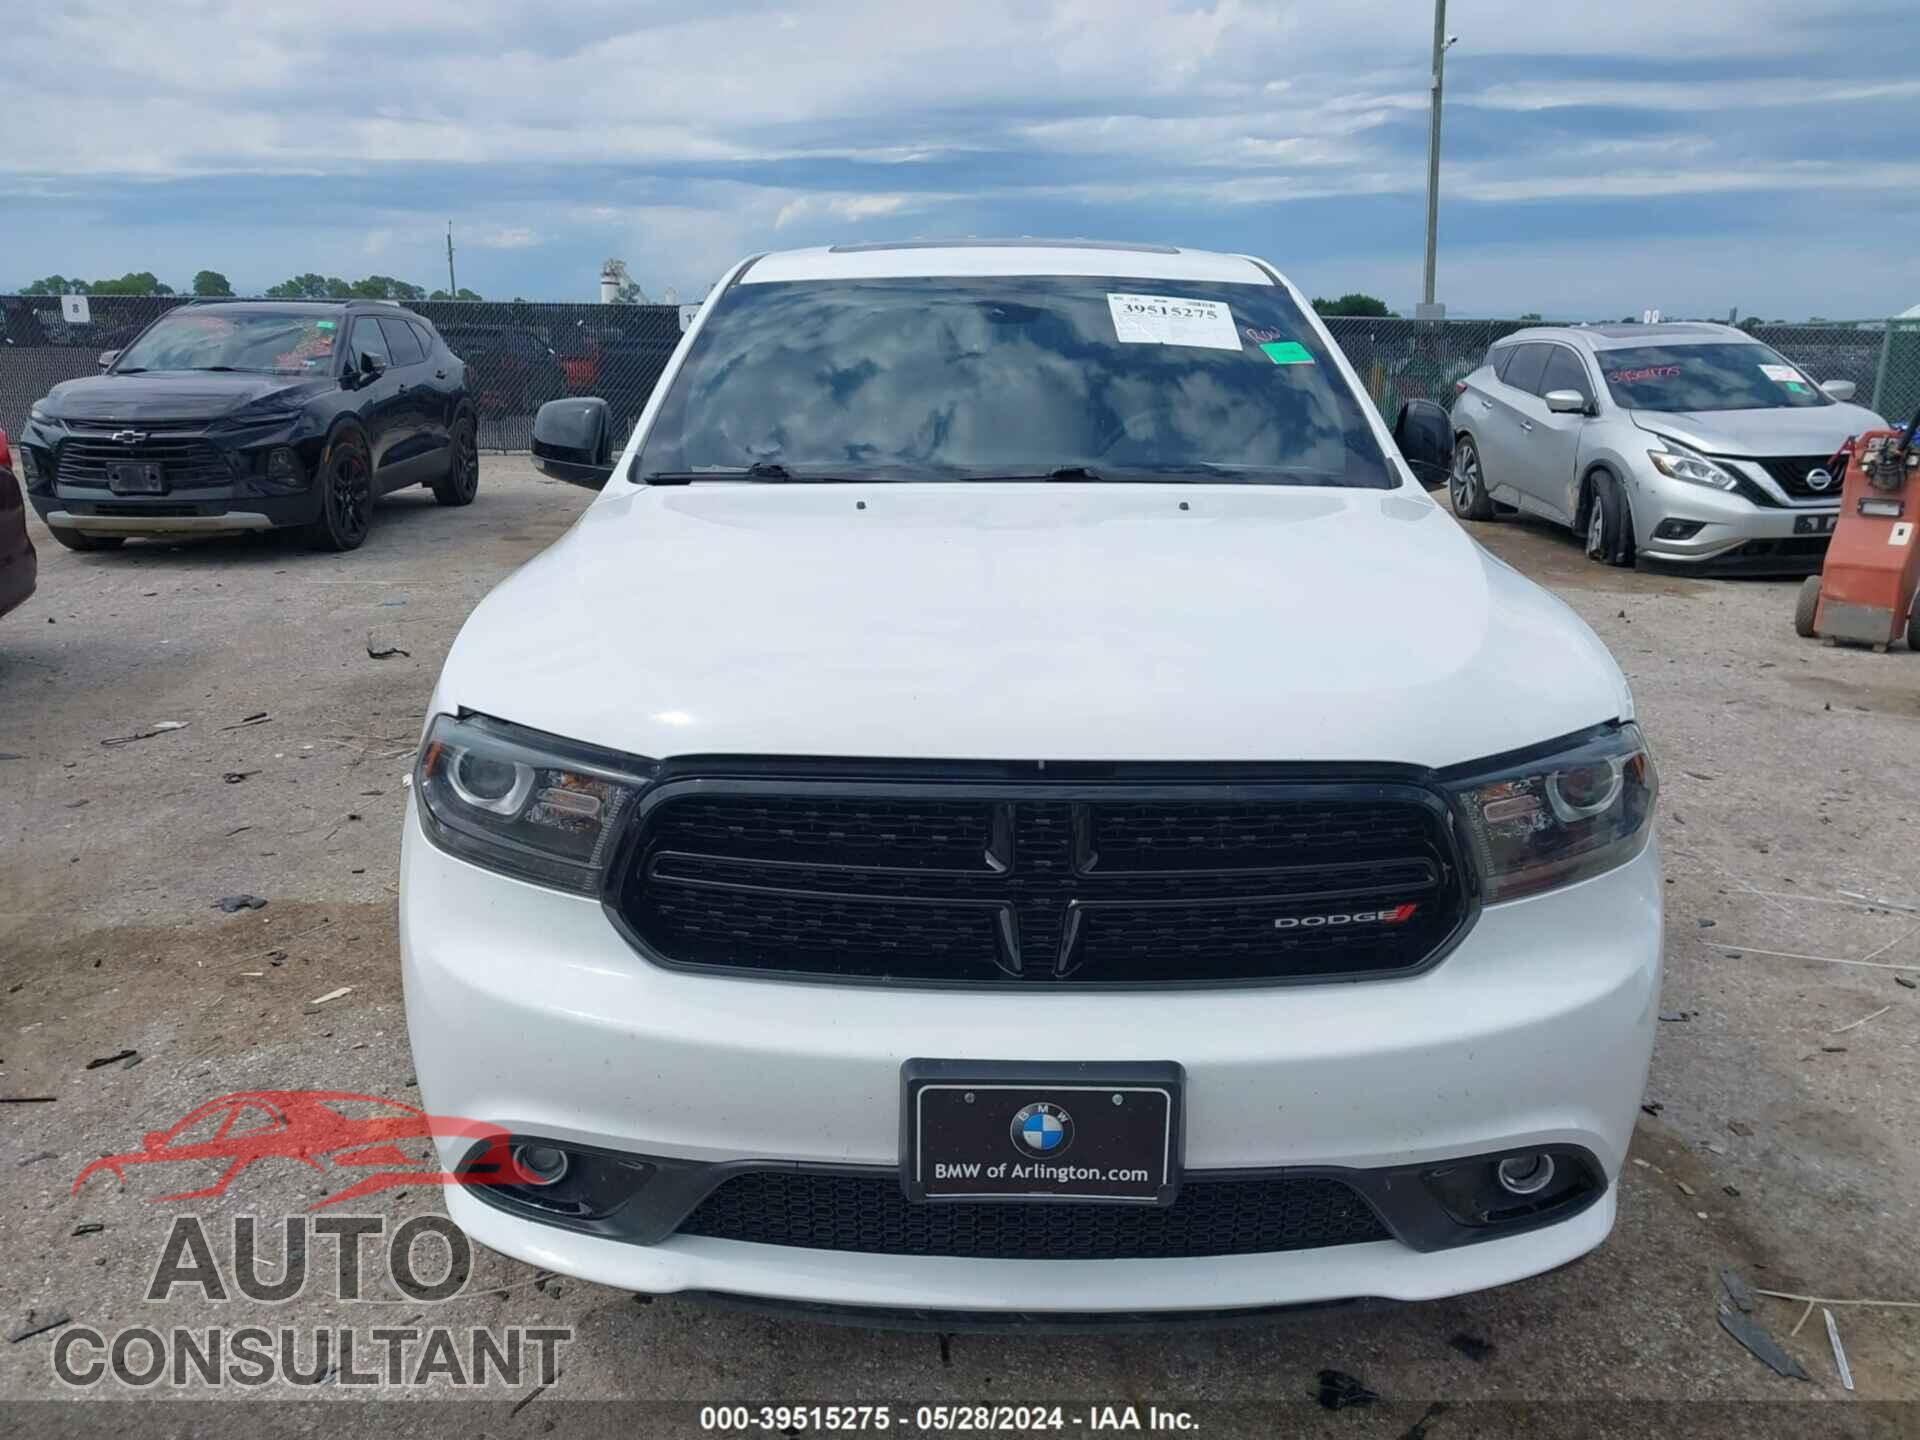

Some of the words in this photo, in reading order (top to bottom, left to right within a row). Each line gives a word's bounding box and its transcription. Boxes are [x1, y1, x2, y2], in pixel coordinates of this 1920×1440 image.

[1122, 303, 1218, 320] 39515275
[1274, 909, 1399, 929] DODGE
[1017, 1103, 1069, 1123] BMW
[934, 1163, 982, 1179] BMW
[987, 1162, 1008, 1179] of
[1011, 1164, 1149, 1183] Arlington.com
